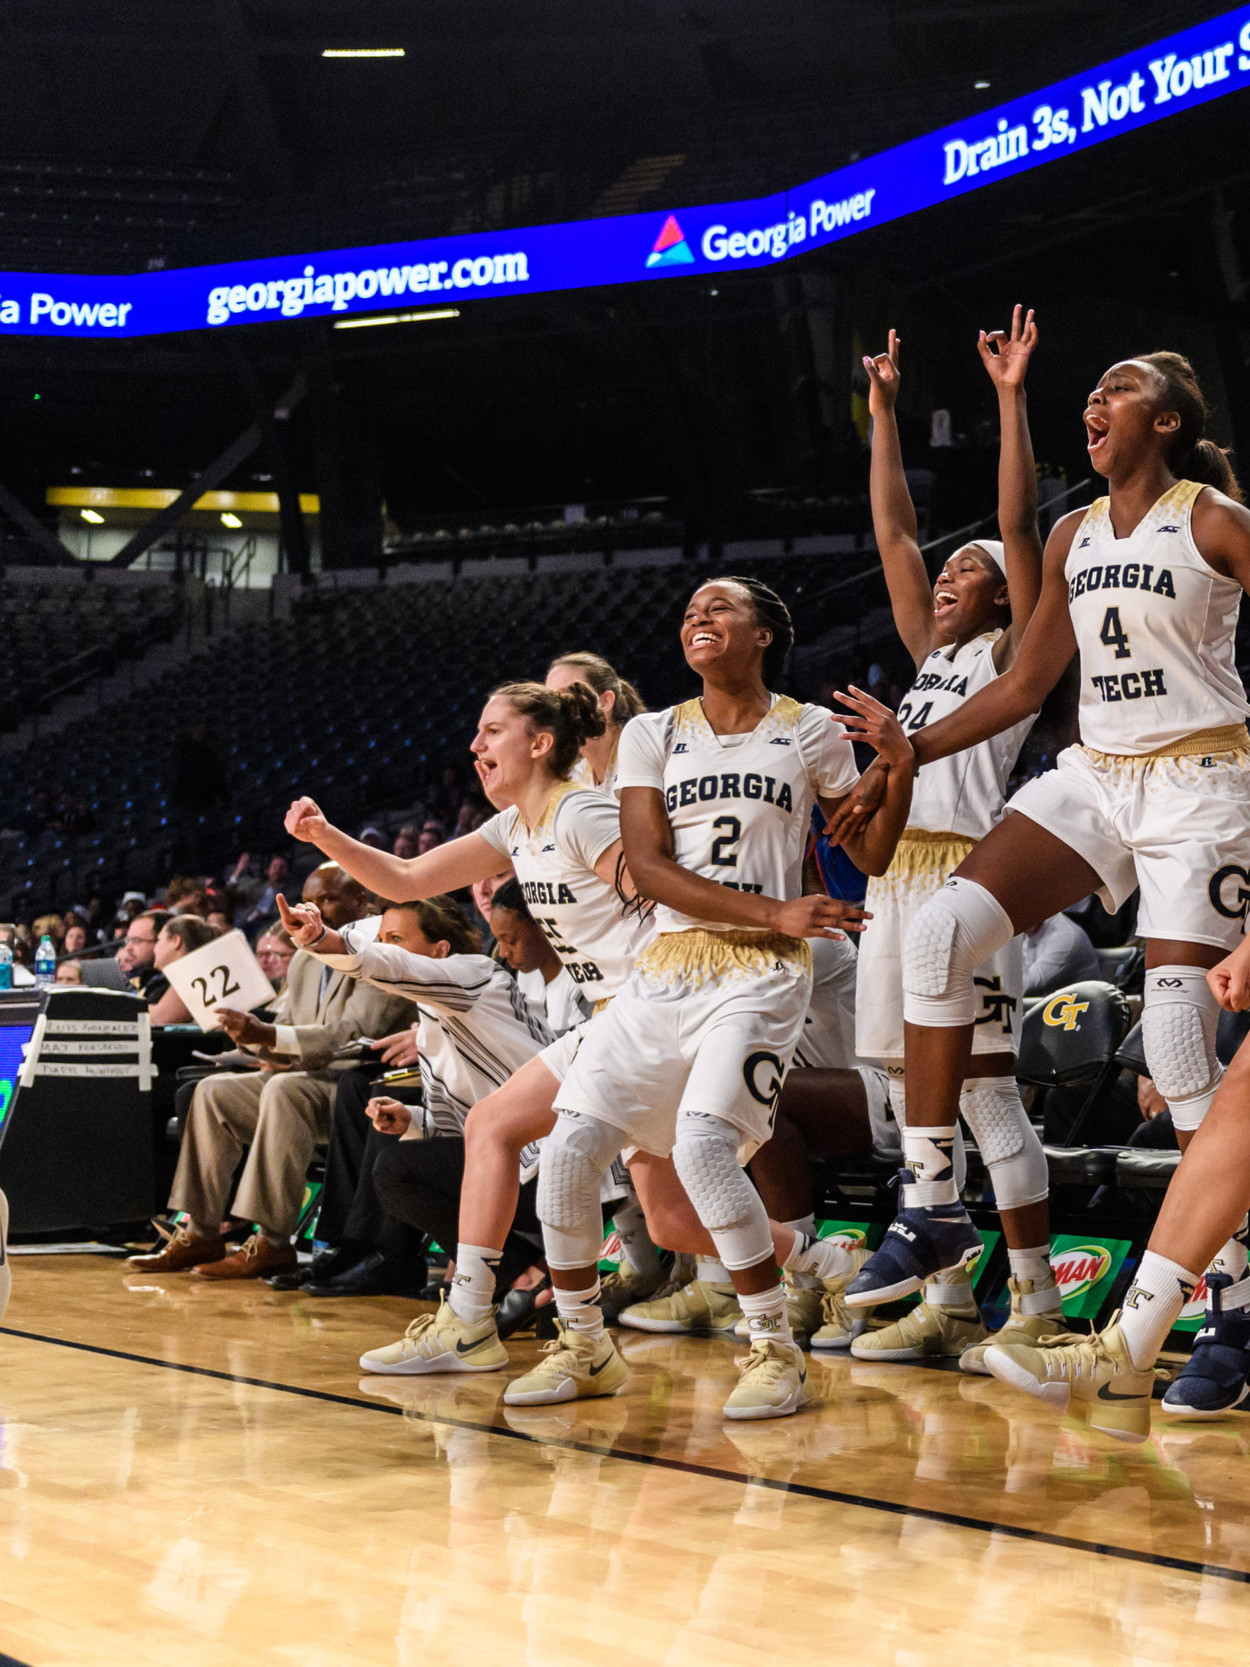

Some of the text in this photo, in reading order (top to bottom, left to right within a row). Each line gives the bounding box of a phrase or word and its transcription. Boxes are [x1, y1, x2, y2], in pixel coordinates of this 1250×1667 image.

[943, 117, 1029, 185] Drain
[1031, 104, 1077, 151] 3s,
[1080, 70, 1146, 133] Not
[1147, 40, 1235, 105] Your
[701, 181, 877, 262] Georgia Power
[29, 292, 134, 328] Power
[206, 251, 531, 326] georgiapower.com
[1099, 605, 1132, 660] 4
[1091, 668, 1168, 702] TECH
[666, 773, 794, 814] GEORGIA
[710, 815, 743, 868] 2
[191, 964, 241, 1008] 22
[1043, 993, 1090, 1031] GT
